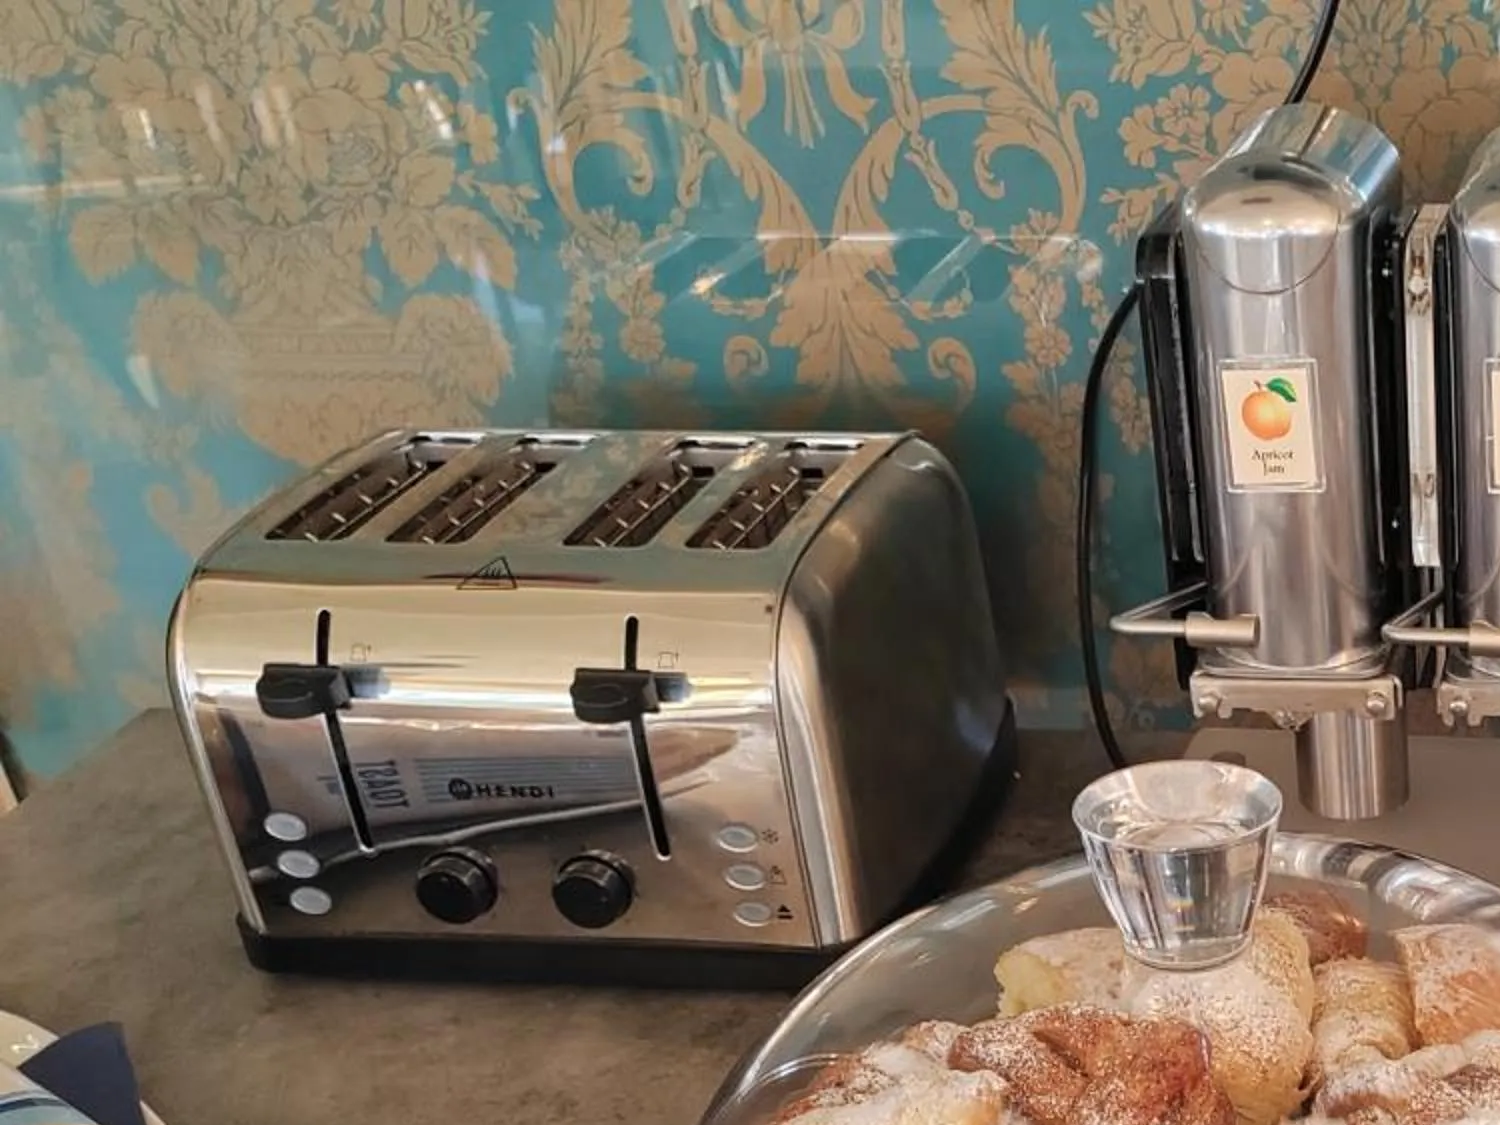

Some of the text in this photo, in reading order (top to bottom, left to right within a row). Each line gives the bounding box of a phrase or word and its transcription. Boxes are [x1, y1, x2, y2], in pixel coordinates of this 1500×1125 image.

[1251, 449, 1295, 463] Apricot
[1262, 462, 1286, 477] Jam
[472, 783, 555, 799] HENDI
